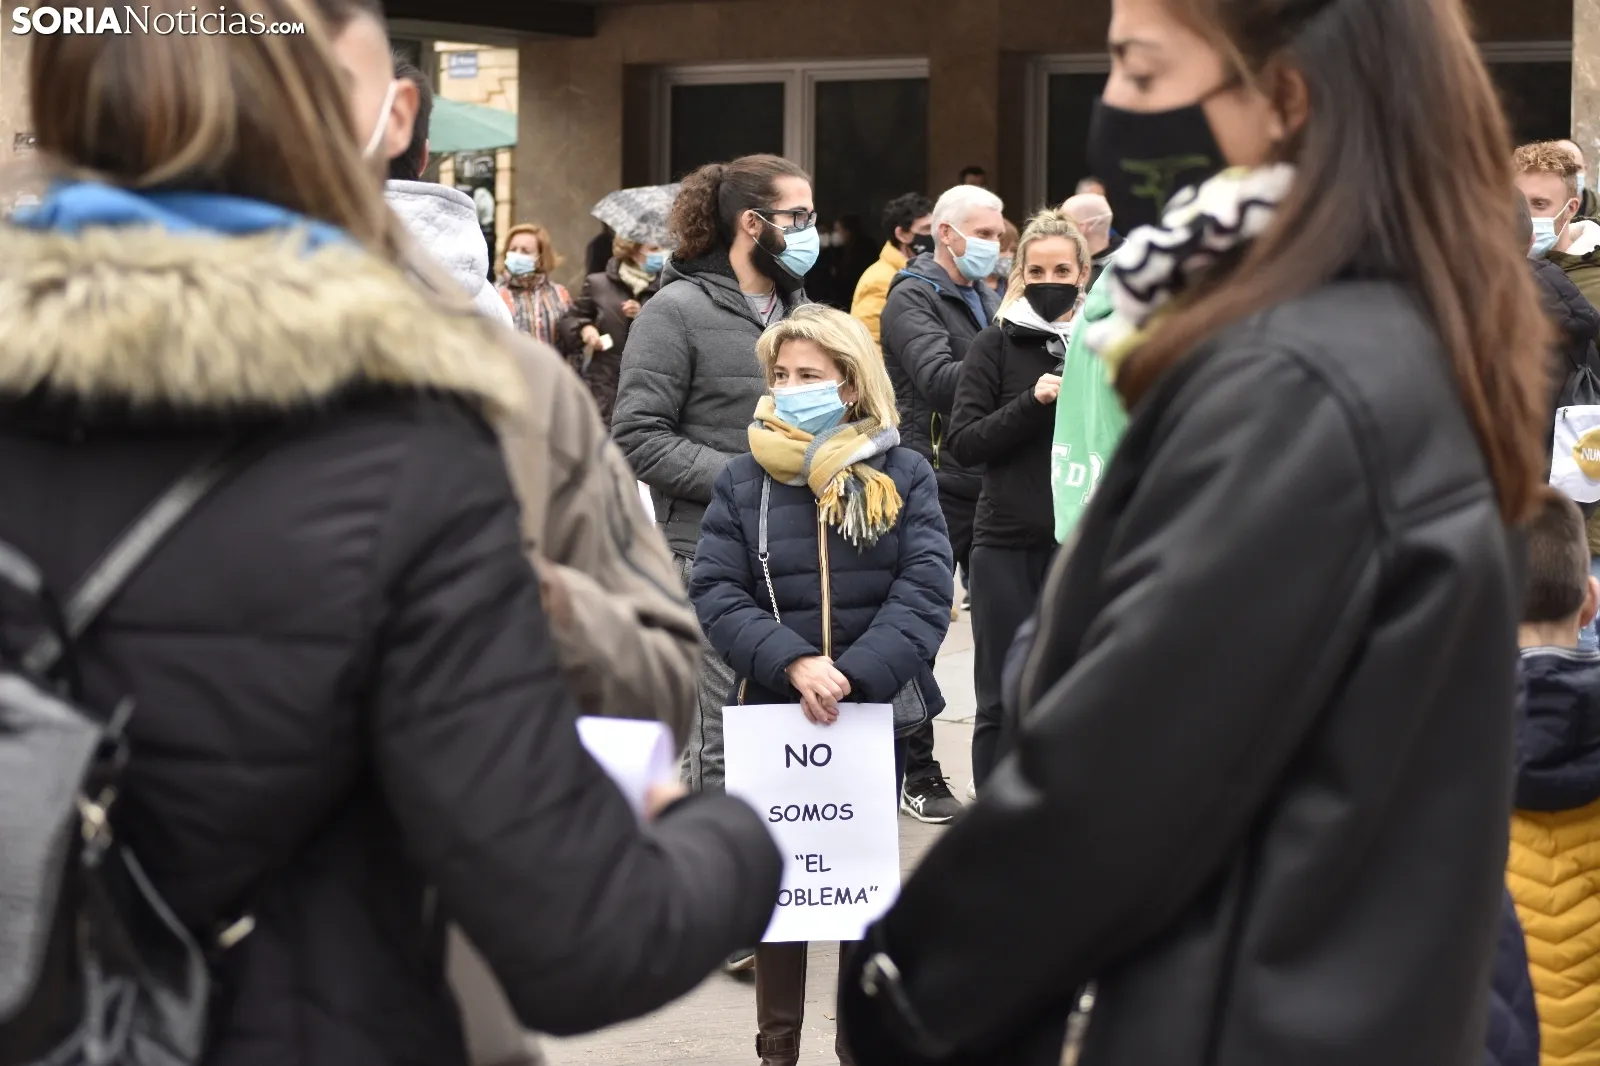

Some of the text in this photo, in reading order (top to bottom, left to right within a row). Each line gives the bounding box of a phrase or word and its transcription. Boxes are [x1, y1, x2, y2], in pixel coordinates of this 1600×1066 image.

[784, 743, 832, 768] NO
[768, 803, 854, 823] SOMOS
[776, 886, 878, 907] OBLEMA”
